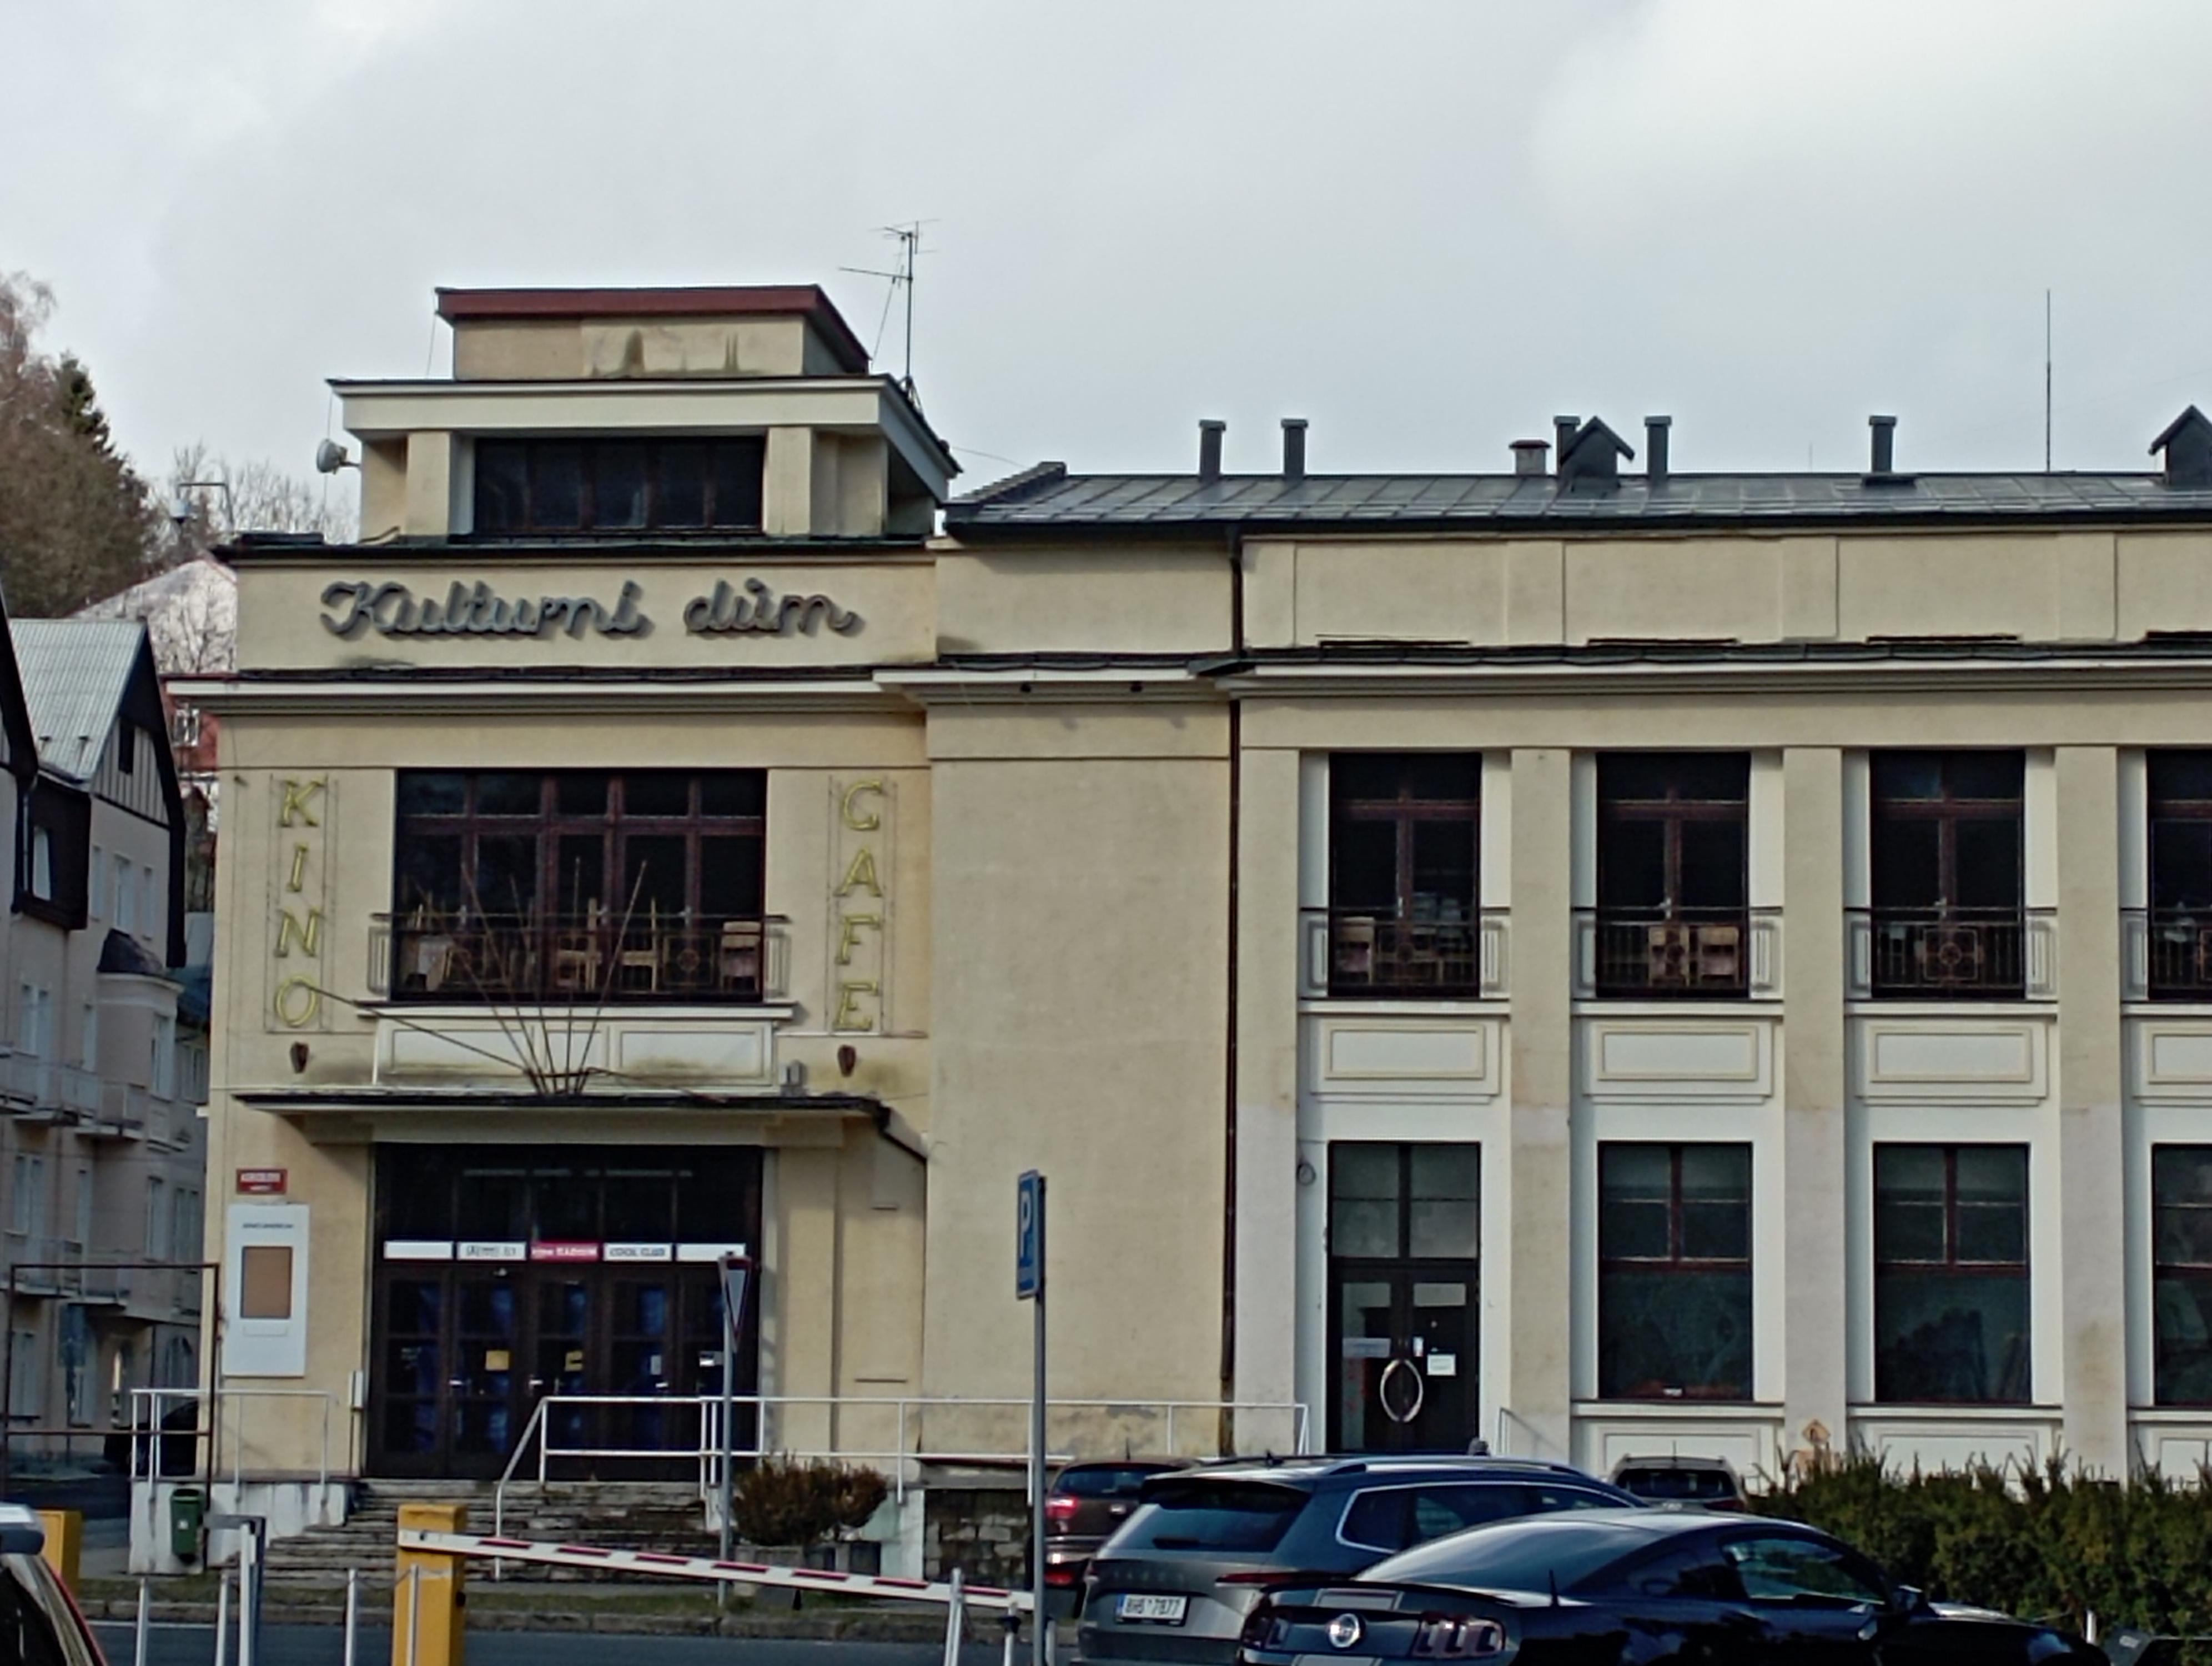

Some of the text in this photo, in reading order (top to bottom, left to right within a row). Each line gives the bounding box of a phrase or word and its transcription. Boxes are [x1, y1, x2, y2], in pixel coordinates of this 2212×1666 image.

[274, 779, 325, 1027] KINO
[833, 780, 882, 1032] CAFE
[1020, 1191, 1032, 1258] P
